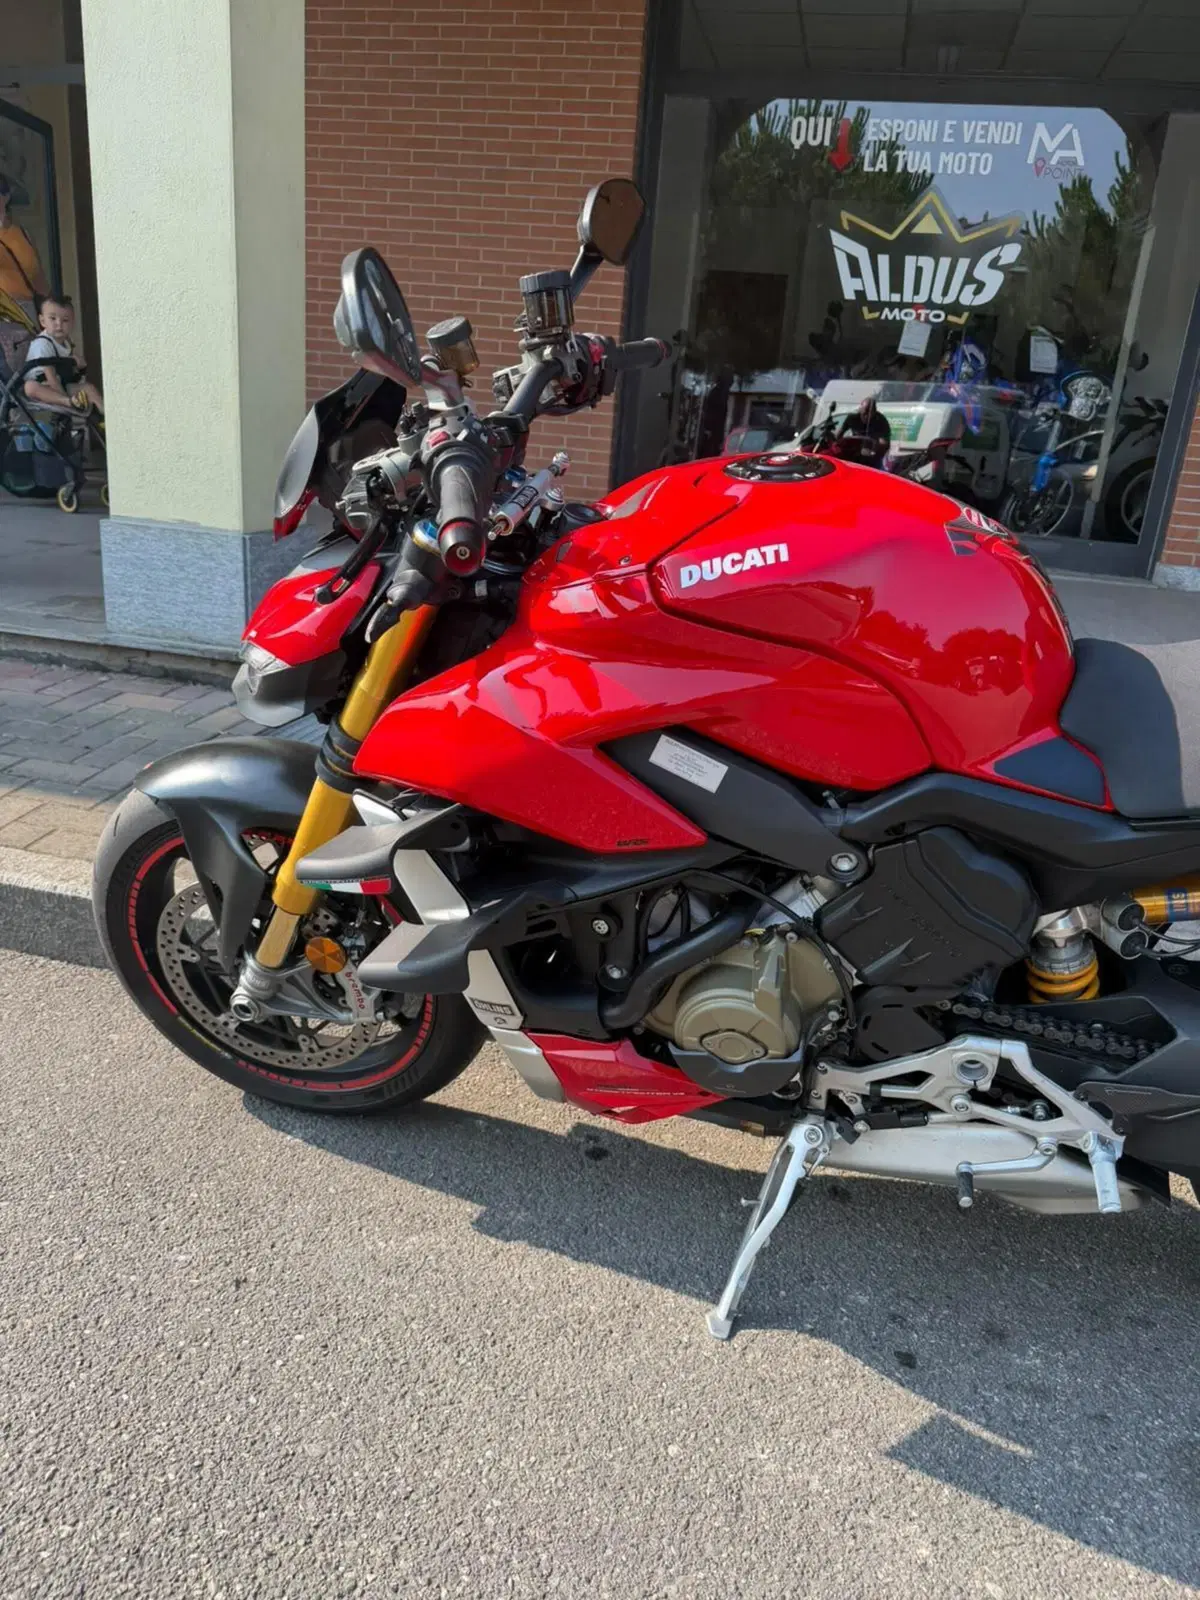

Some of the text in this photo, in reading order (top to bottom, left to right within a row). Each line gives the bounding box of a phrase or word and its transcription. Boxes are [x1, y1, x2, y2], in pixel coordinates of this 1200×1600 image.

[790, 116, 834, 150] QUI
[867, 118, 1024, 145] ESPONI E VENDI
[863, 149, 993, 175] LA TUA MOTO
[1044, 166, 1084, 180] POINT
[829, 228, 1022, 306] ALDUS
[881, 307, 945, 323] MOTO
[680, 543, 789, 589] DUCATI
[344, 971, 366, 1010] brembo
